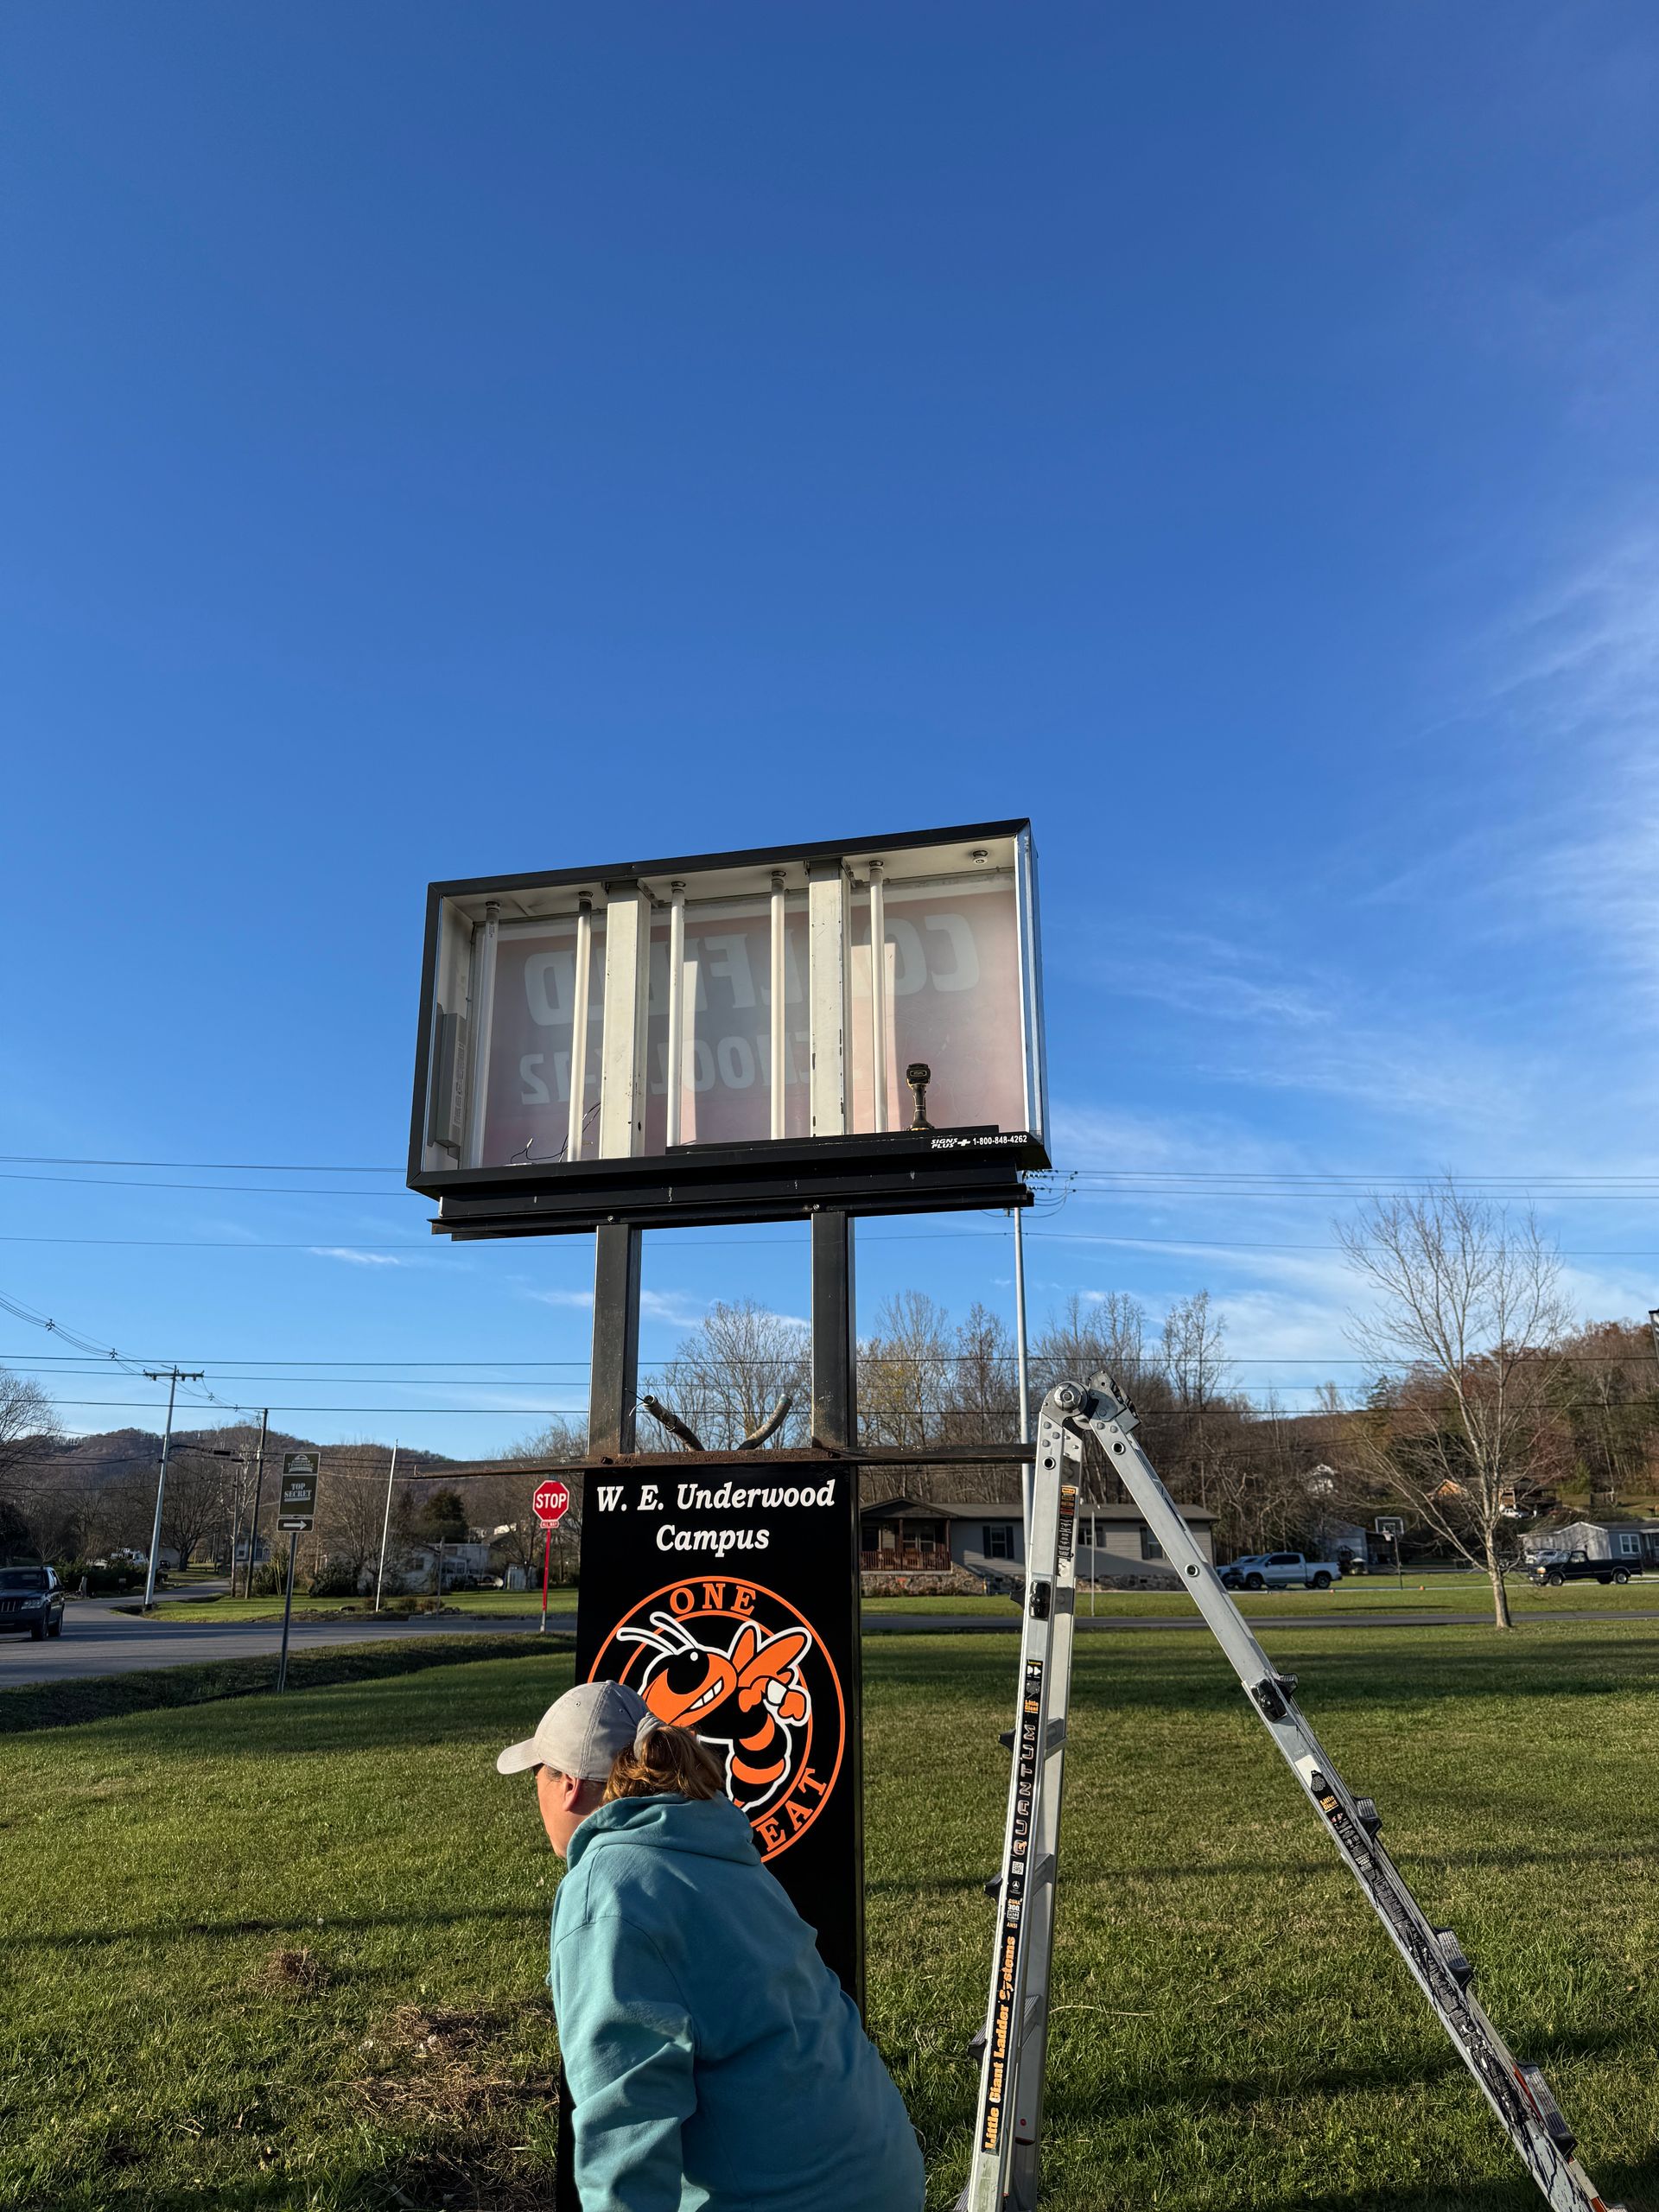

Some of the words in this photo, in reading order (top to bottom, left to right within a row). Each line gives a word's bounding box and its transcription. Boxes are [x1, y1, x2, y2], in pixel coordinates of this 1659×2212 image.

[972, 1135, 1027, 1145] 1-800-848-4262
[283, 1490, 312, 1498] SECRET
[536, 1493, 567, 1509] STOP
[596, 1485, 627, 1512] W.
[637, 1484, 664, 1510] E.
[677, 1478, 836, 1510] Underwood
[656, 1523, 771, 1558] Campus
[669, 1582, 756, 1617] ONE
[1013, 1724, 1036, 1856] QUANTUM
[999, 1936, 1016, 2002] Systems
[993, 2004, 1009, 2059] Ladder
[988, 2062, 1004, 2103] Giant
[984, 2107, 1000, 2150] Little
